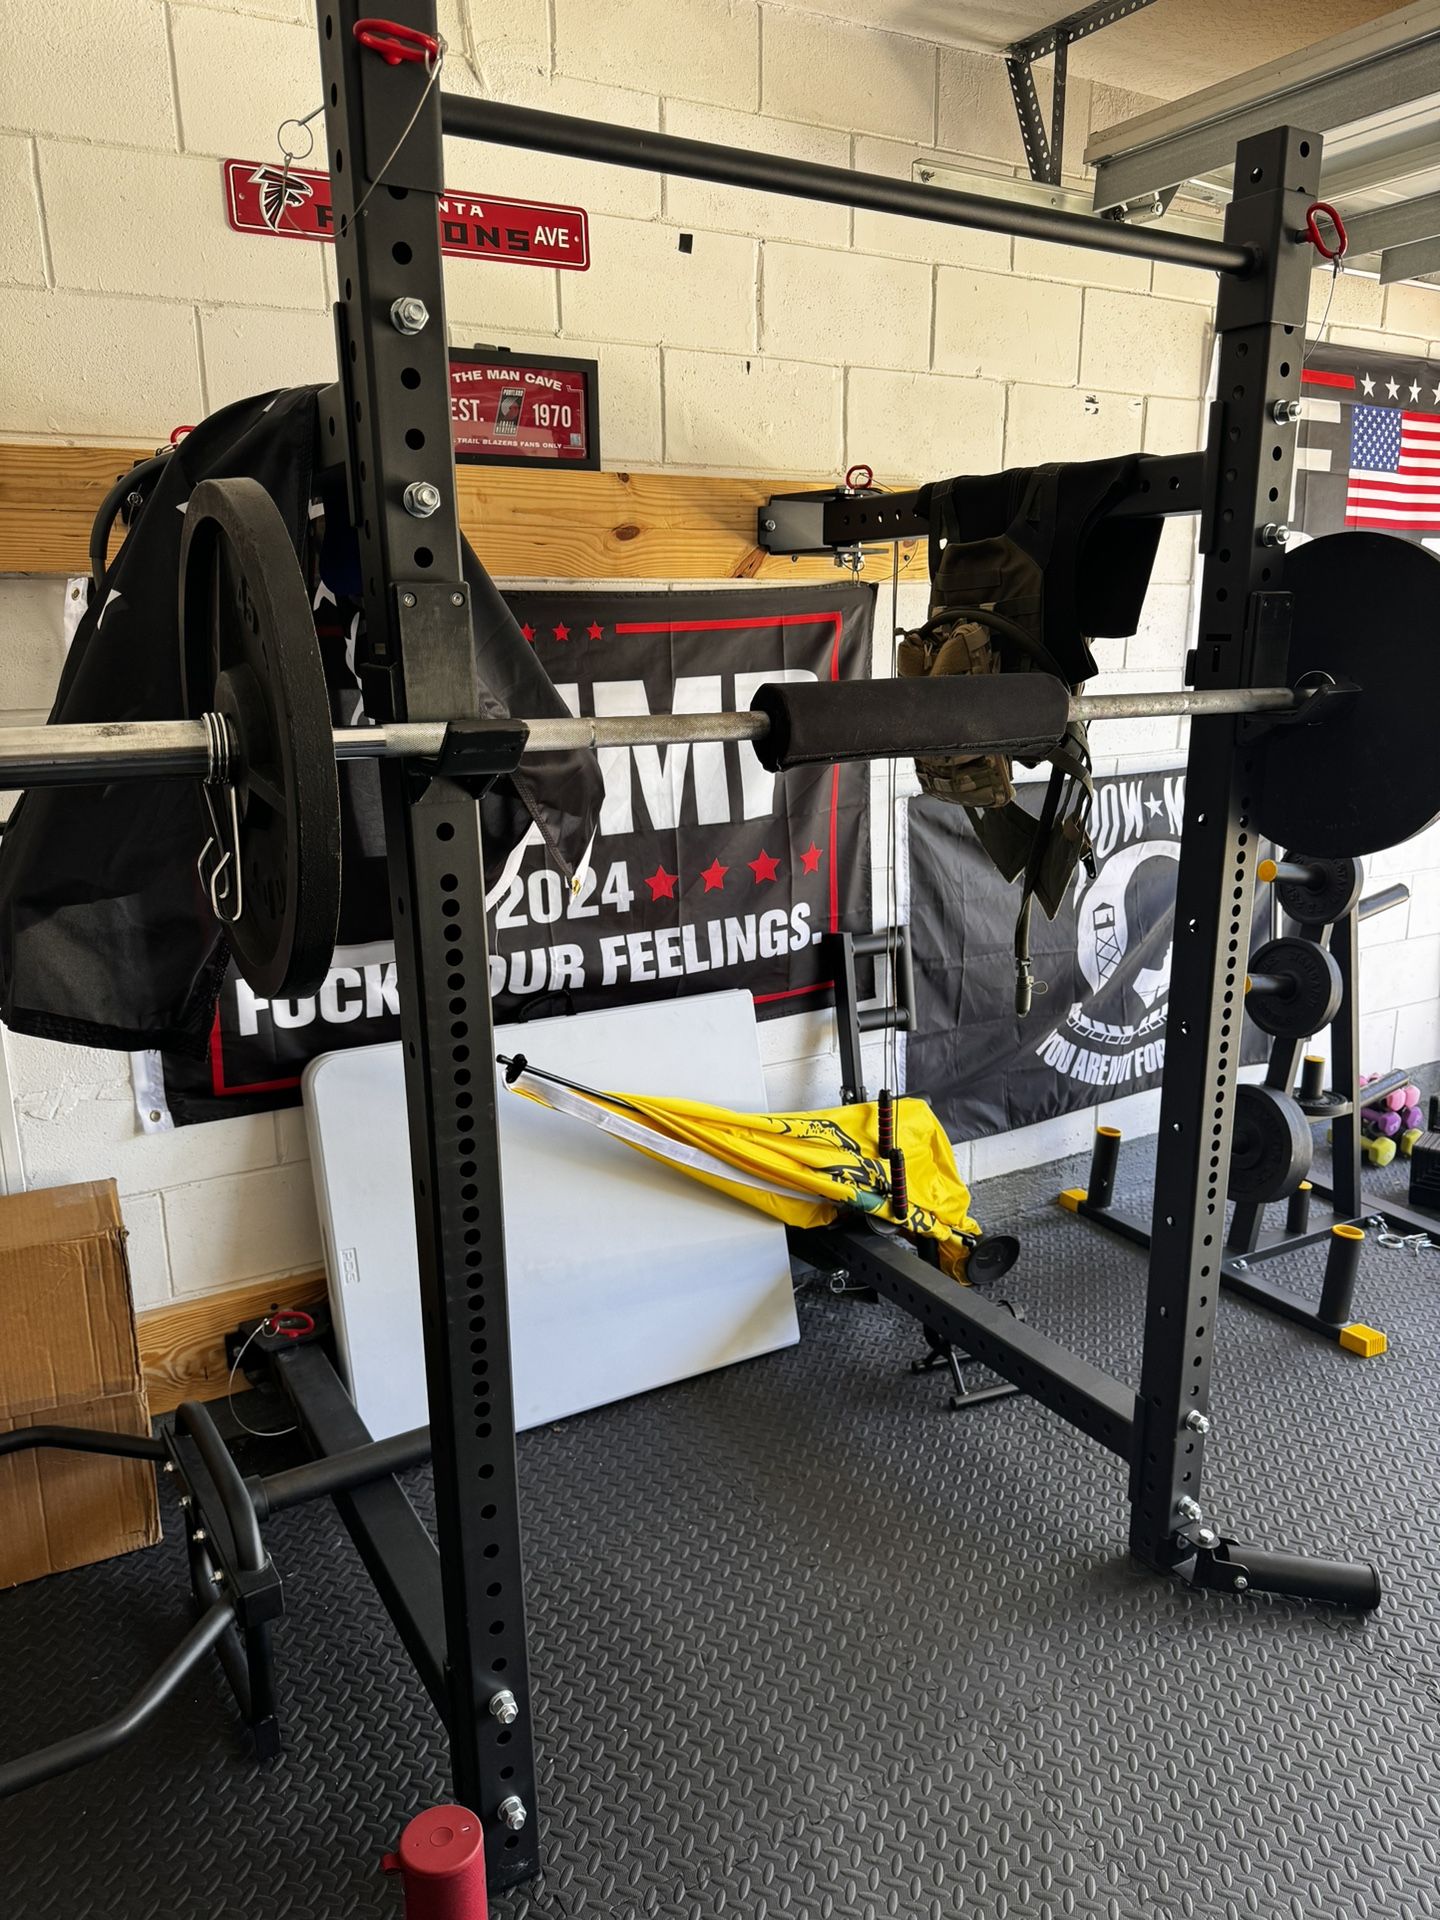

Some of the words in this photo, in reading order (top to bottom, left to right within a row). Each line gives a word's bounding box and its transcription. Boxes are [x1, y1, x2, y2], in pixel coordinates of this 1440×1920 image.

[534, 225, 570, 248] AVE
[452, 370, 483, 383] THE
[487, 369, 520, 381] MAN
[525, 373, 563, 391] CAVE
[450, 398, 484, 422] EST.
[532, 403, 572, 428] 1970
[457, 437, 480, 445] TRAIL
[482, 439, 518, 447] BLAZERS
[520, 441, 541, 449] FANS
[495, 861, 634, 930] 2024
[599, 902, 822, 986] FEELINGS.
[1036, 1028, 1077, 1074] YOU
[1070, 1048, 1111, 1086] ARE
[1104, 1050, 1135, 1086] NOT
[1134, 1039, 1166, 1078] FOR
